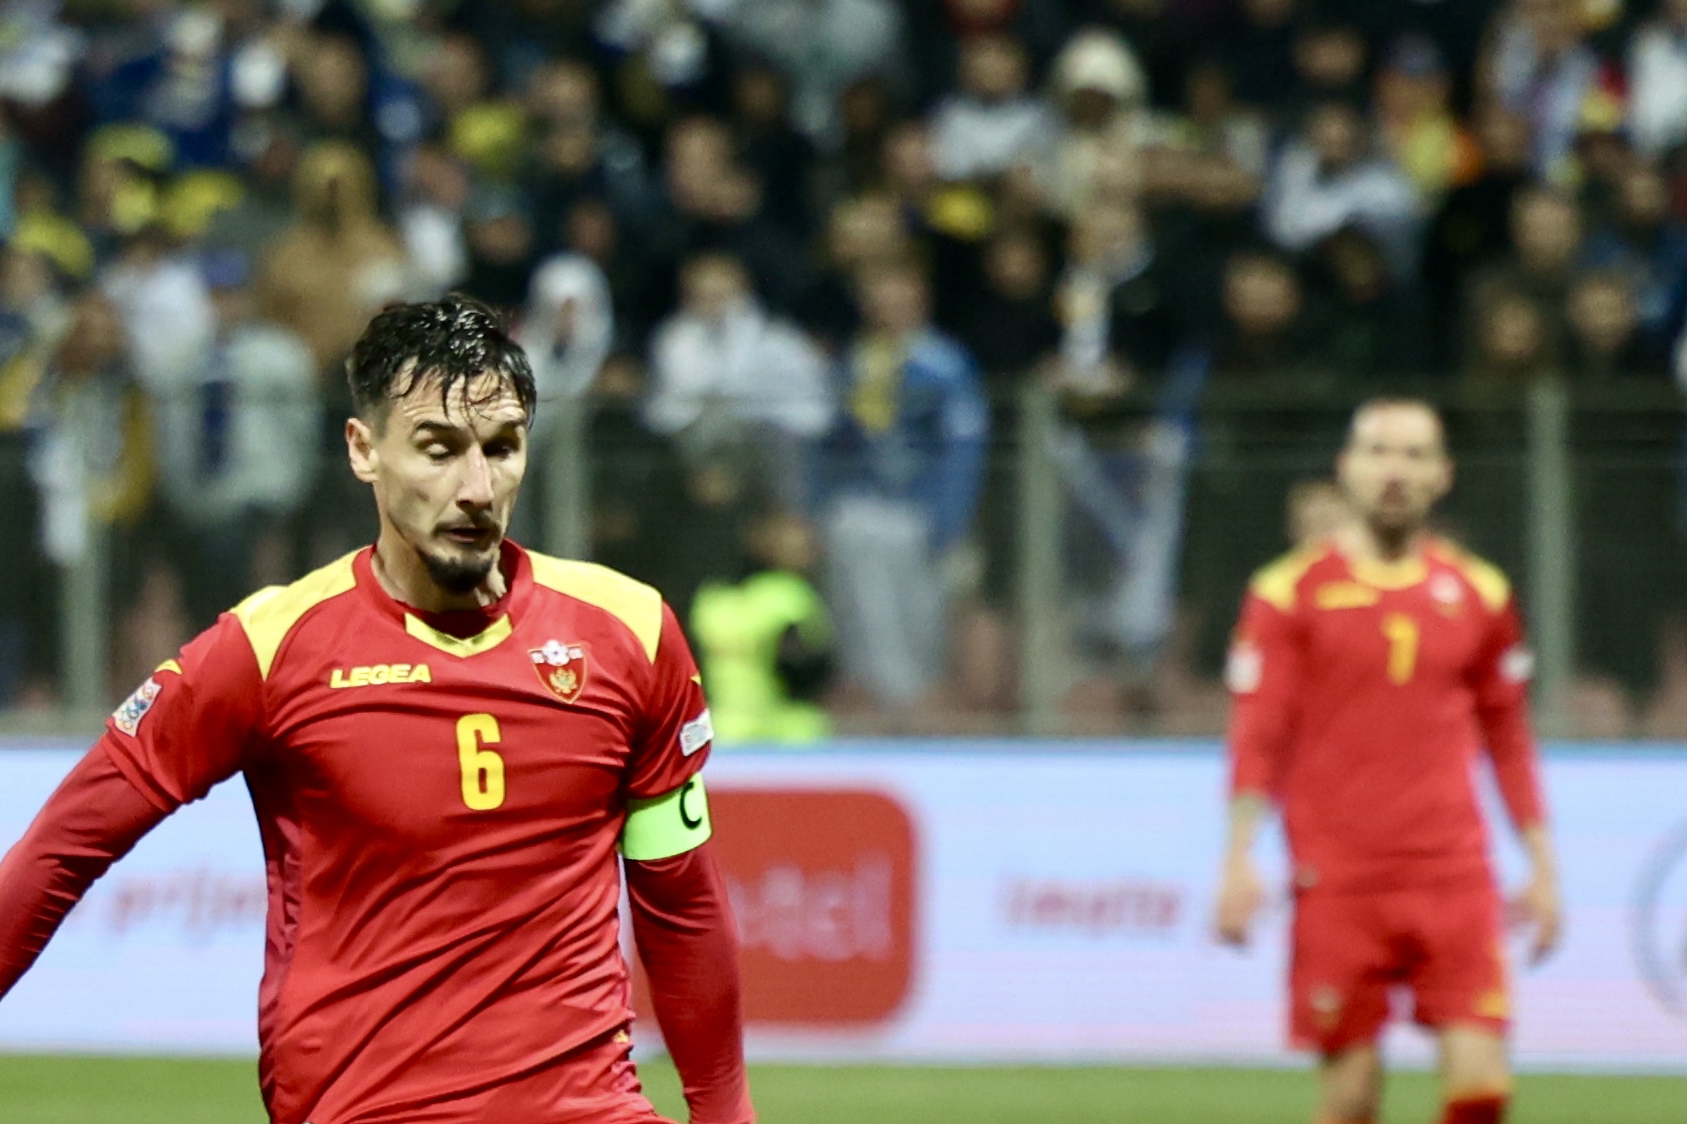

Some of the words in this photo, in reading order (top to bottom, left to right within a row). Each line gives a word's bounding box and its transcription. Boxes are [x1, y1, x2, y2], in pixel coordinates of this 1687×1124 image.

[330, 664, 432, 688] LEGEA
[456, 713, 506, 810] 6
[679, 781, 702, 829] C
